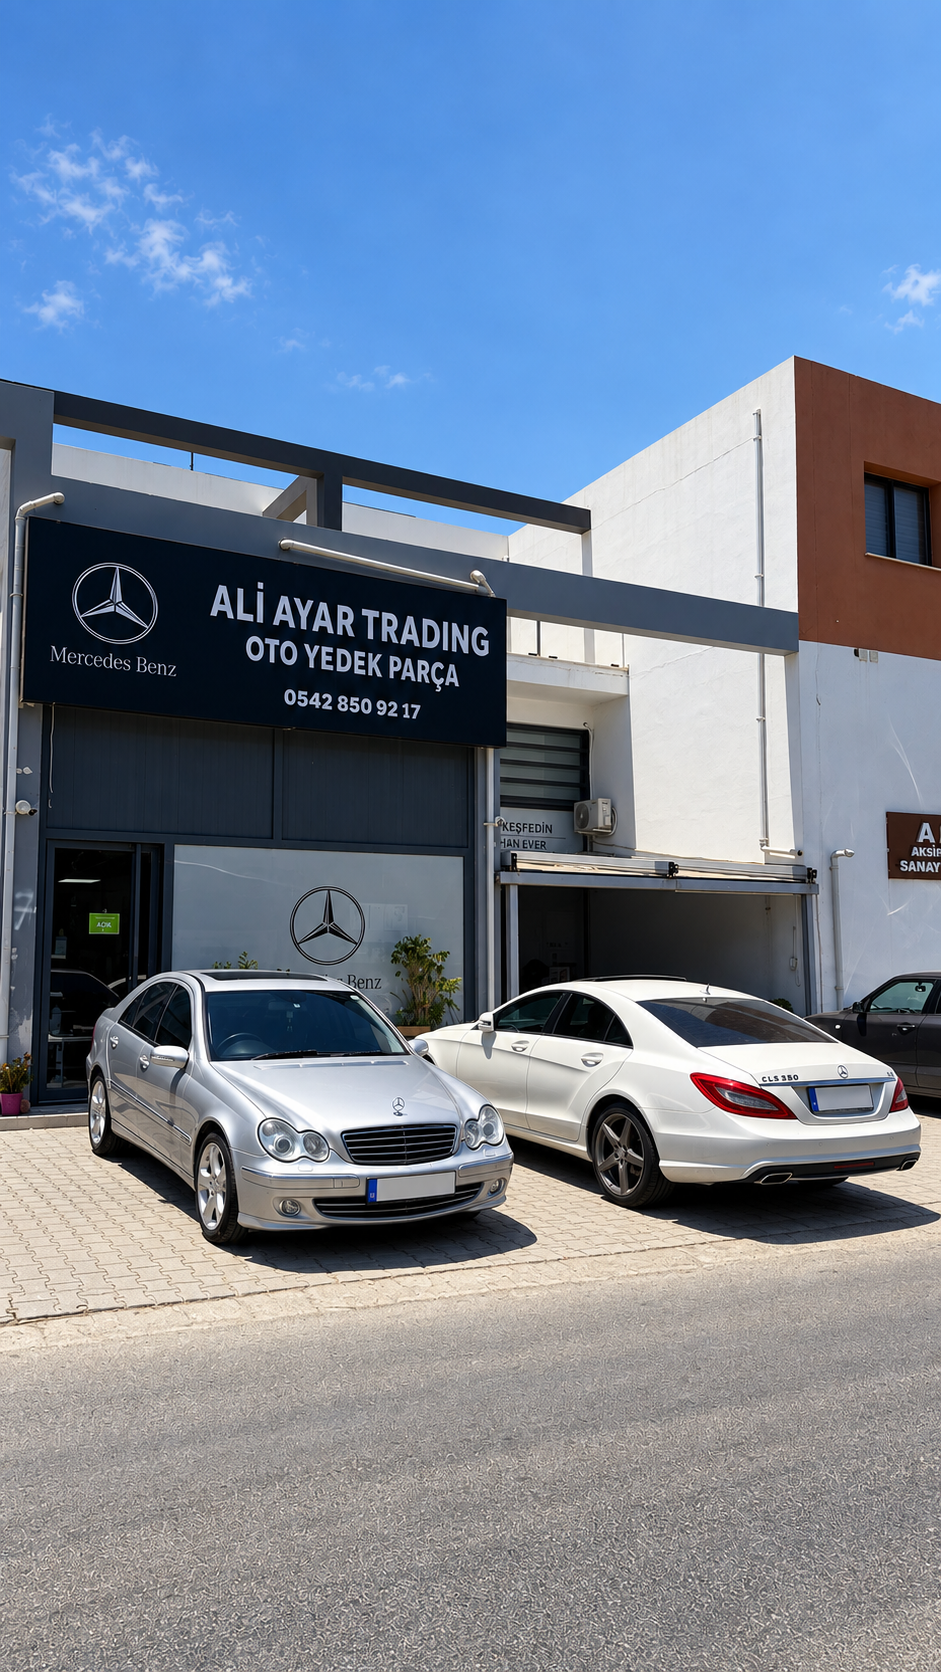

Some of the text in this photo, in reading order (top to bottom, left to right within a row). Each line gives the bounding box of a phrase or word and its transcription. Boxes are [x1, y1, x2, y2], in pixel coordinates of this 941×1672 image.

[210, 581, 490, 657] ALİ AYAR TRADING
[49, 645, 177, 677] Mercedes Benz
[246, 635, 460, 693] OTO YEDEK PARÇA
[284, 688, 421, 720] 0542 850 92 17
[502, 821, 553, 835] KEŞFEDİN
[917, 822, 941, 844] A
[522, 839, 548, 851] EVER
[899, 860, 941, 873] SANAY
[347, 974, 382, 990] Benz
[761, 1075, 780, 1083] CLS
